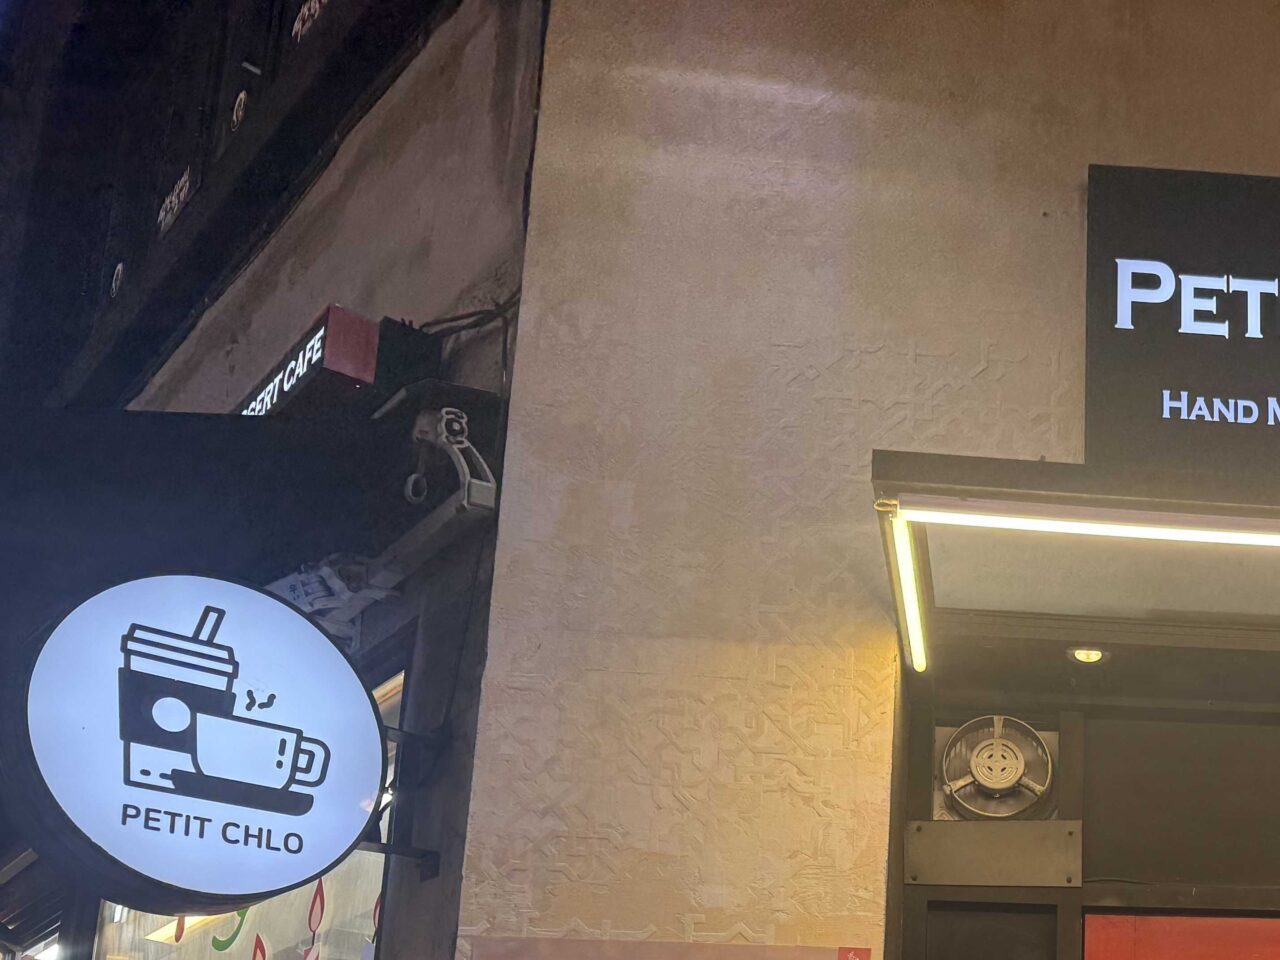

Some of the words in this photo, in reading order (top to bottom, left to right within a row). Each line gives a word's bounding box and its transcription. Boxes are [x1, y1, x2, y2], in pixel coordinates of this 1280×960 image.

[283, 325, 325, 392] CAFE
[120, 803, 213, 840] PETIT
[220, 821, 304, 855] CHLO
